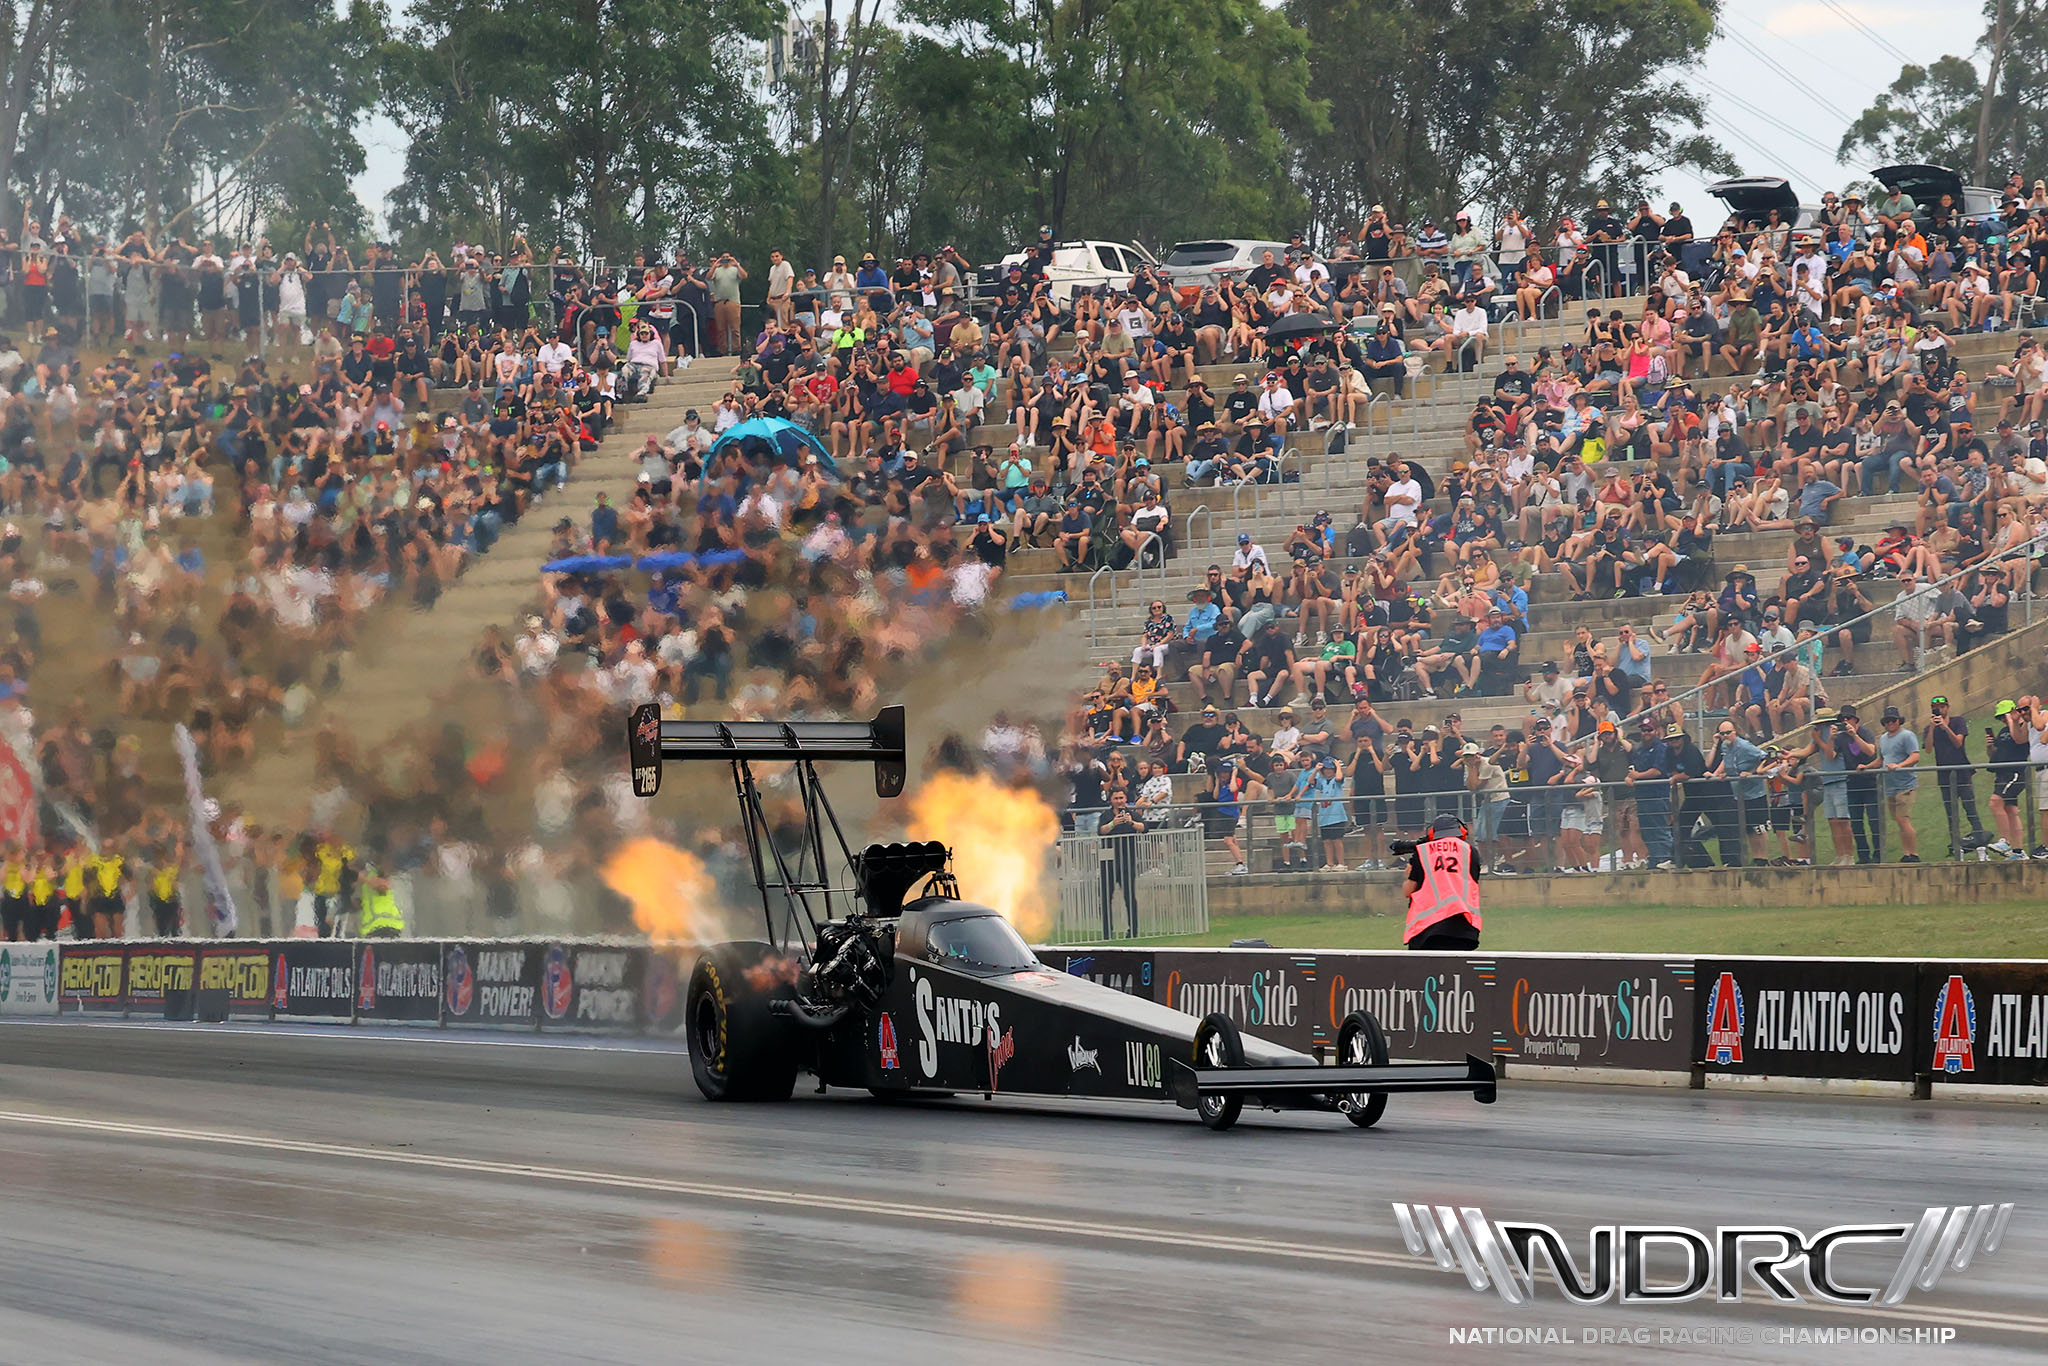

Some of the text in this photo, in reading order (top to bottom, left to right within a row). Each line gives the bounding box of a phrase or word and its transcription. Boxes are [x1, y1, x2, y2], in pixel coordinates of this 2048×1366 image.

[1429, 842, 1459, 854] MEDIA
[1434, 856, 1458, 873] A2
[290, 966, 351, 999] ATLANTIC OILS
[377, 961, 438, 998] ATLANTIC OILS
[480, 985, 535, 1016] POWER!
[1166, 969, 1298, 1033] CountrySide
[1329, 973, 1475, 1049] CountrySide
[1512, 978, 1674, 1057] CountrySide
[1754, 990, 1904, 1055] ATLANTIC OILS
[1524, 1037, 1580, 1060] Property Group
